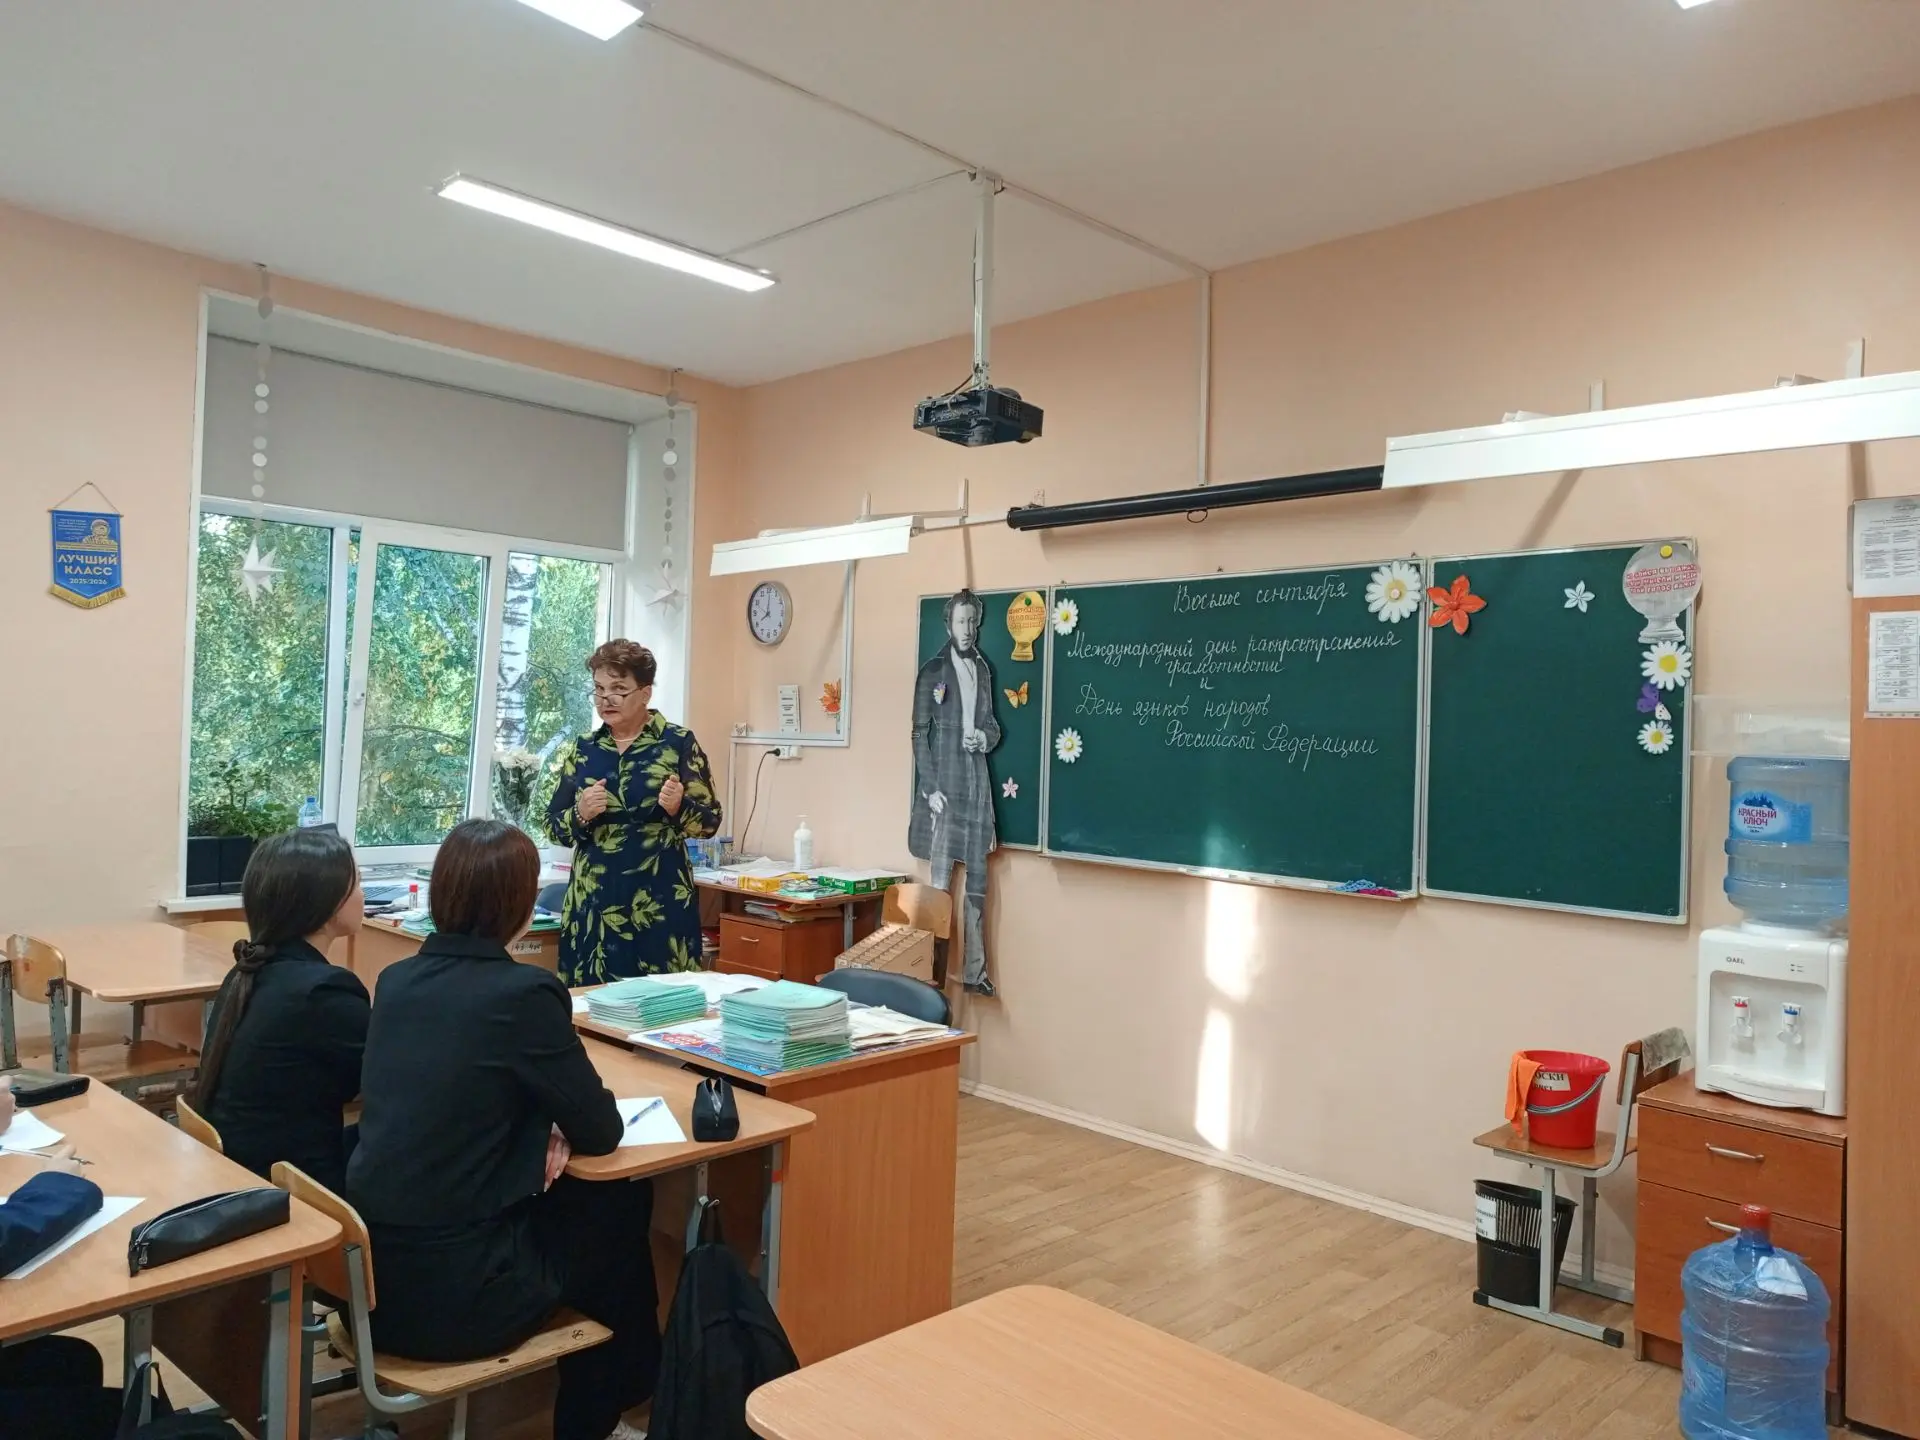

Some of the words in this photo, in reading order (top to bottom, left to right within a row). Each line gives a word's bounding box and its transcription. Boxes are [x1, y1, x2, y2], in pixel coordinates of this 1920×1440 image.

[57, 554, 117, 565] ЛУЧШИЙ
[64, 566, 113, 576] КЛАСС
[1173, 584, 1241, 613] Восьмое
[1256, 574, 1349, 615] сентября
[1067, 630, 1193, 668] Международный
[1205, 639, 1237, 665] день
[1246, 631, 1402, 662] распространения
[1165, 658, 1284, 687] грамотности
[1199, 677, 1215, 690] и
[1075, 683, 1123, 716] День
[1132, 695, 1190, 726] языков
[1204, 693, 1271, 729] народов
[1165, 719, 1256, 749] Российской
[1262, 723, 1379, 772] Федерации
[1738, 808, 1777, 819] КРАСНЫЙ
[1743, 817, 1768, 826] КЛЮЧ
[1534, 1071, 1564, 1081] ОСКИ
